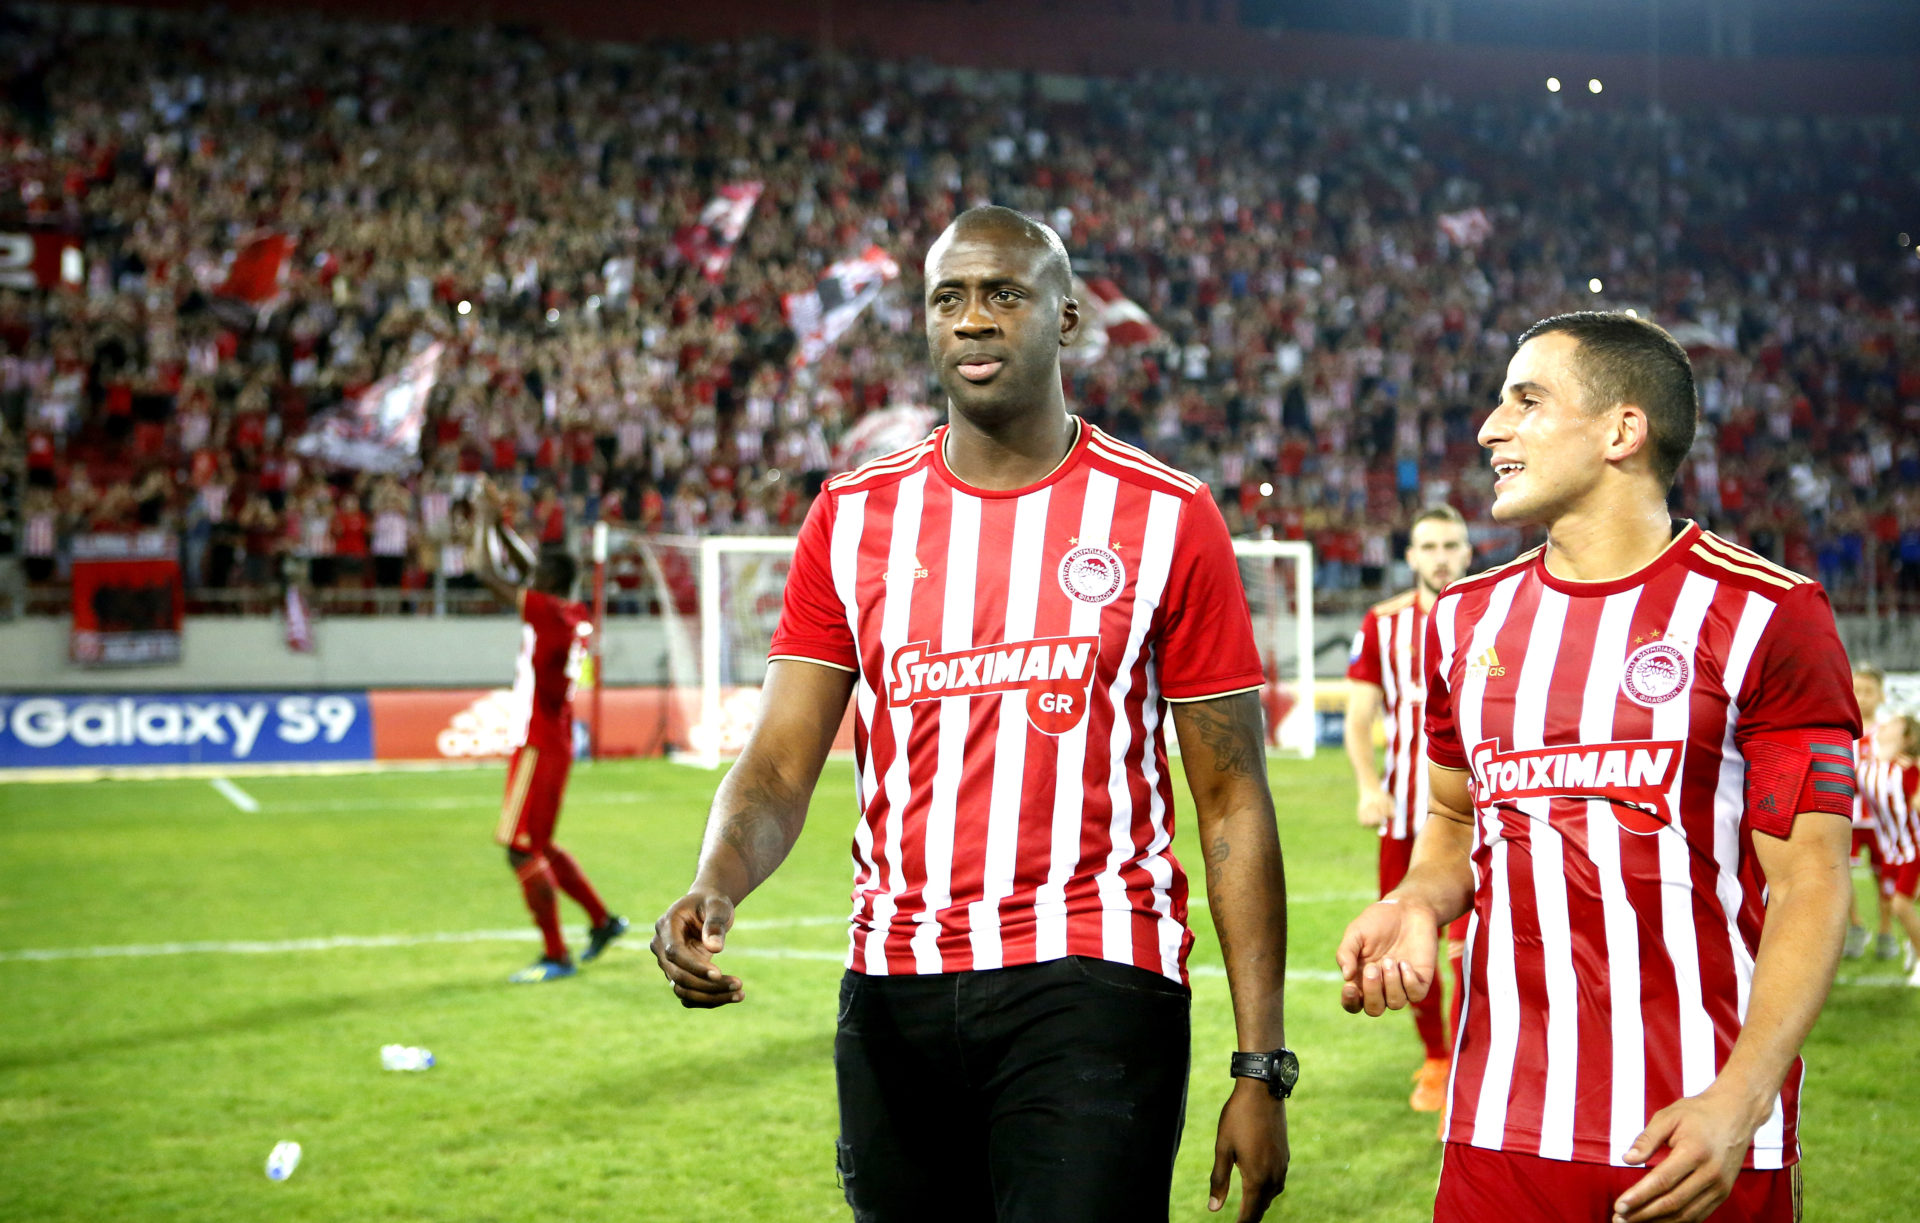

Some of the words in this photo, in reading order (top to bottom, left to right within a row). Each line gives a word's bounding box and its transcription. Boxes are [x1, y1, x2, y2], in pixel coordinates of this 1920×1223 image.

[893, 642, 1092, 702] STOIXIMAN
[10, 697, 268, 759] Galaxy
[276, 696, 357, 744] S9
[1038, 692, 1074, 715] GR
[1474, 748, 1674, 802] STOIXIMAN
